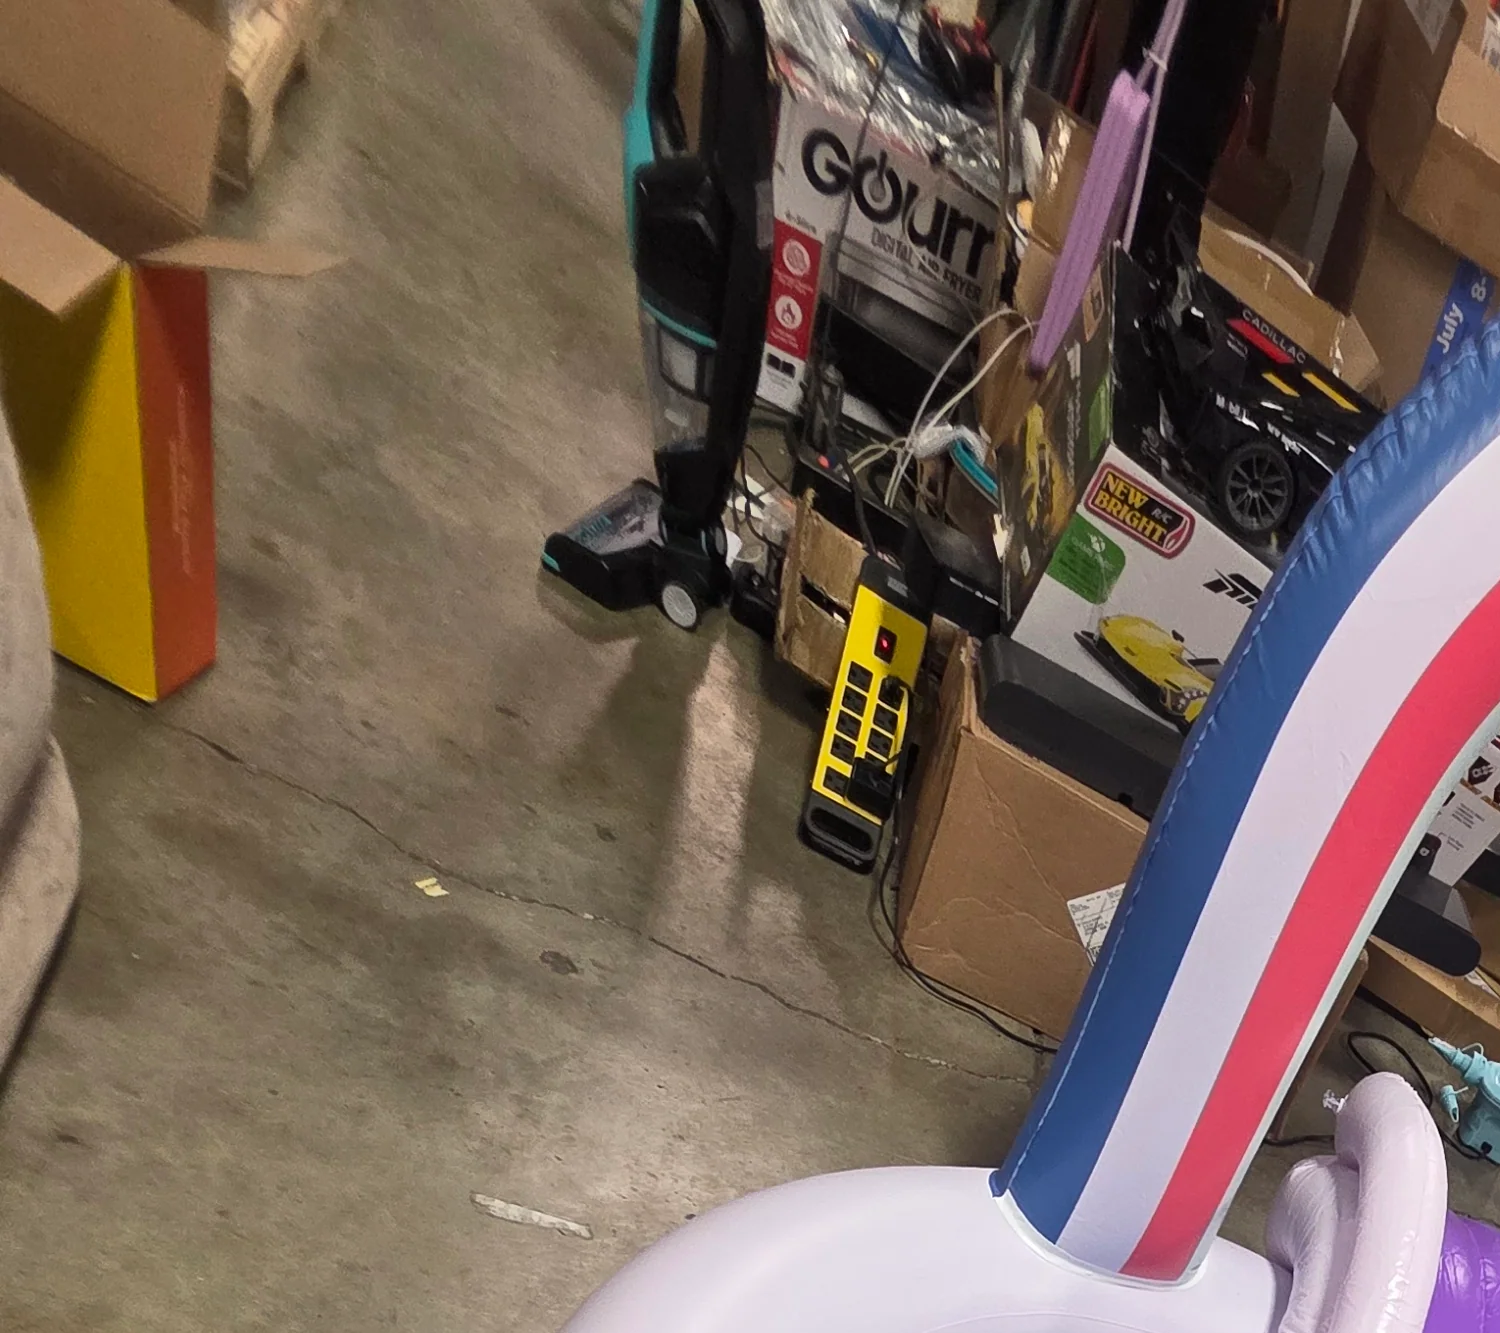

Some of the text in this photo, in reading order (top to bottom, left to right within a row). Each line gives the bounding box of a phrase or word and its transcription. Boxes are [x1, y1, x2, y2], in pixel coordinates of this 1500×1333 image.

[941, 266, 983, 300] FRYER
[1241, 307, 1307, 364] CADILLAC
[1436, 301, 1464, 355] July
[1094, 489, 1168, 544] BRIGHT
[1103, 472, 1149, 509] NEW
